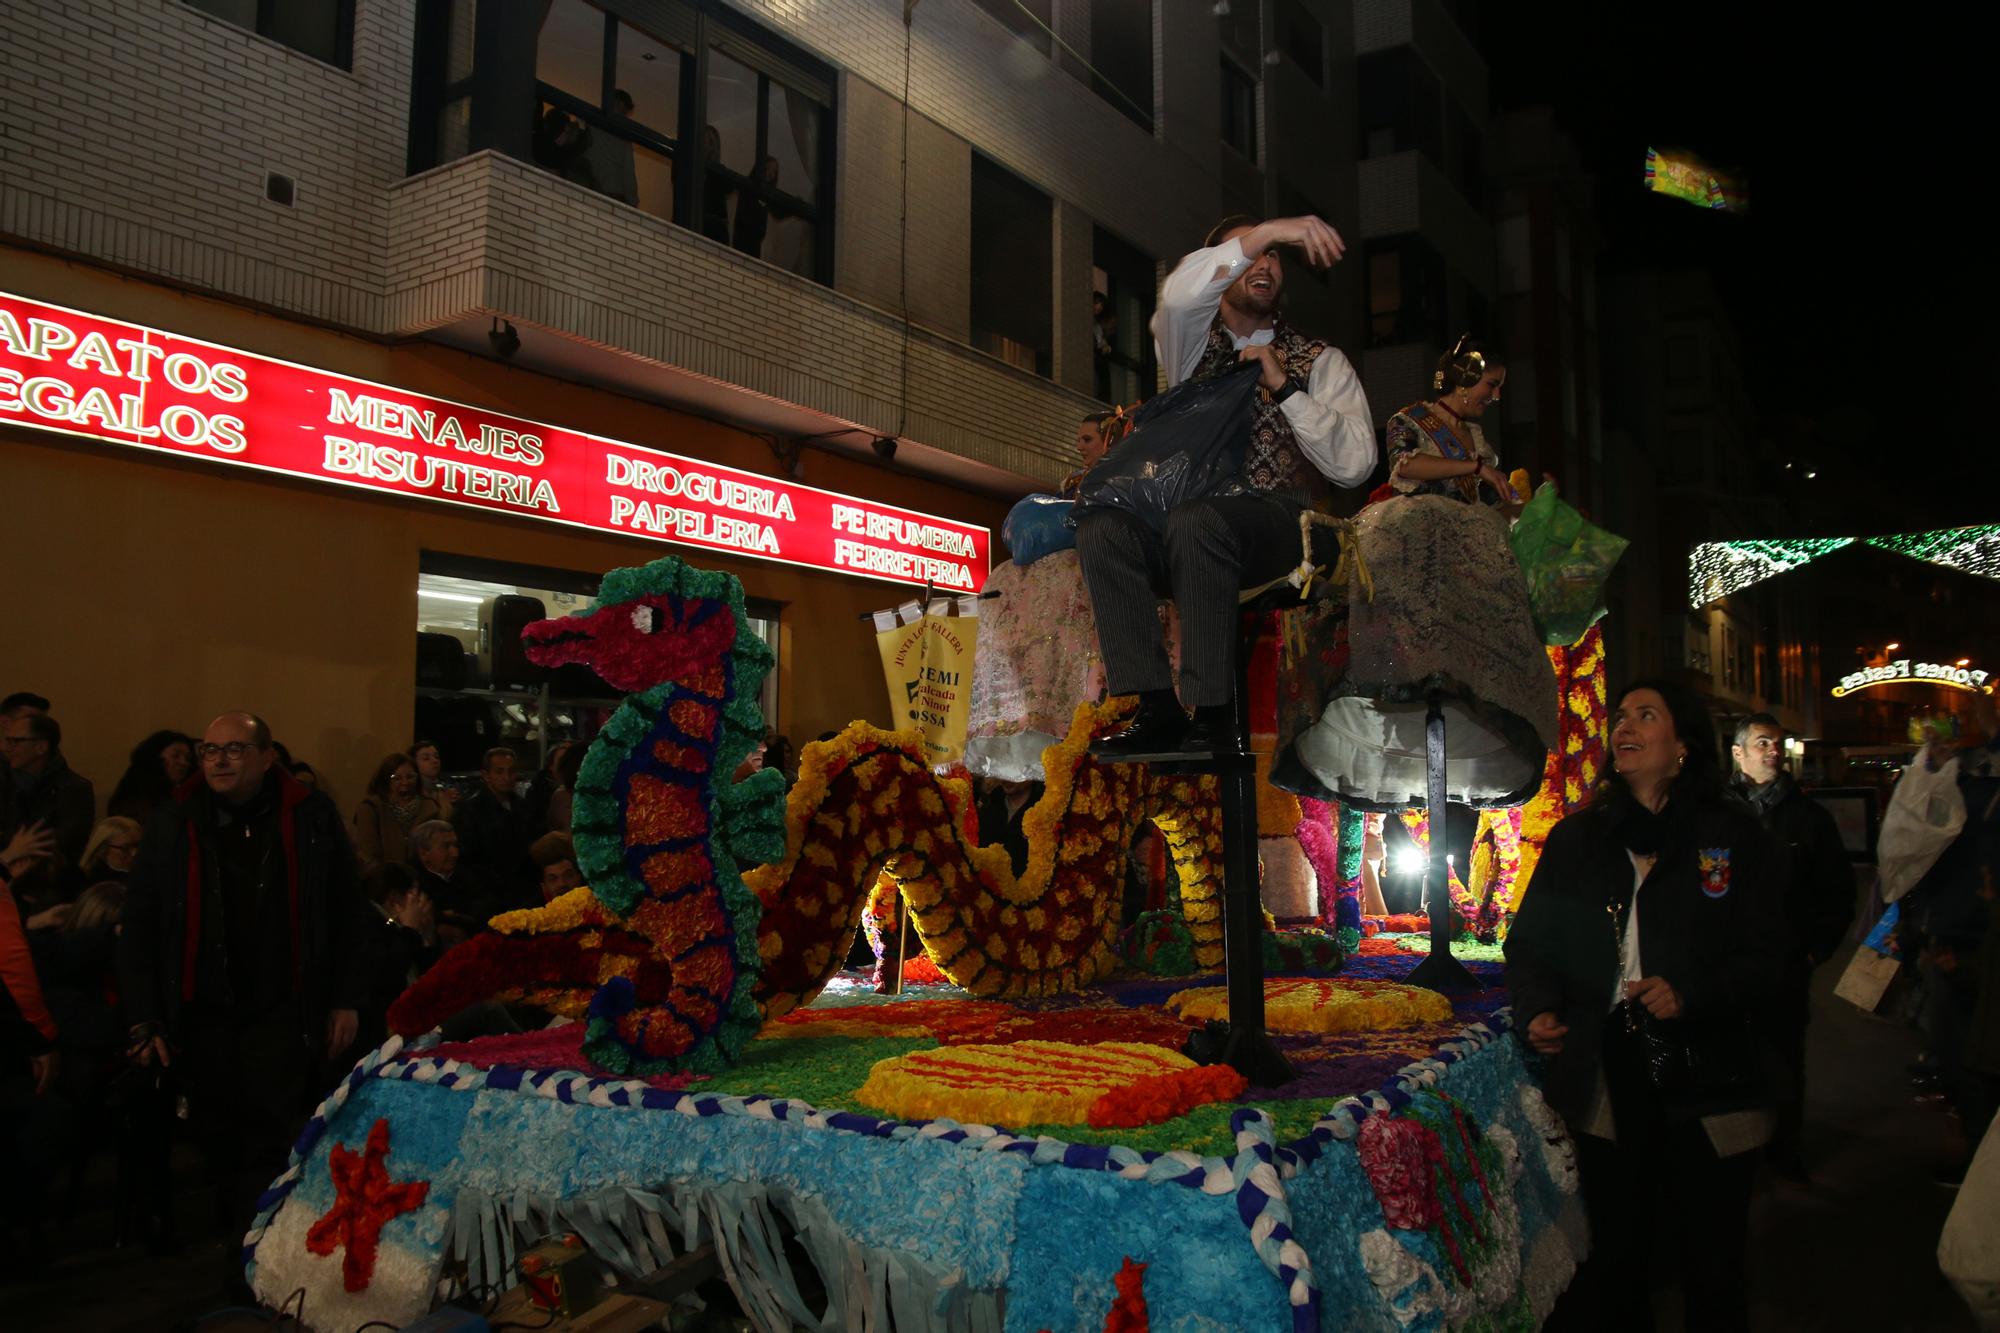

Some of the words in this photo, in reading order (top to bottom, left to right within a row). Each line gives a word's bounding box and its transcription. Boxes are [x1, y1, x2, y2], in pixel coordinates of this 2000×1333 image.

[326, 387, 545, 466] MENAJES
[323, 434, 561, 513] BISUTERIA
[606, 453, 796, 522] DROGUERIA
[610, 495, 781, 555] PAPELERIA
[831, 502, 977, 559] PERFUMERIA
[834, 538, 975, 589] FERRETERIA
[895, 638, 914, 668] JUNTA
[931, 622, 963, 656] FALLERA
